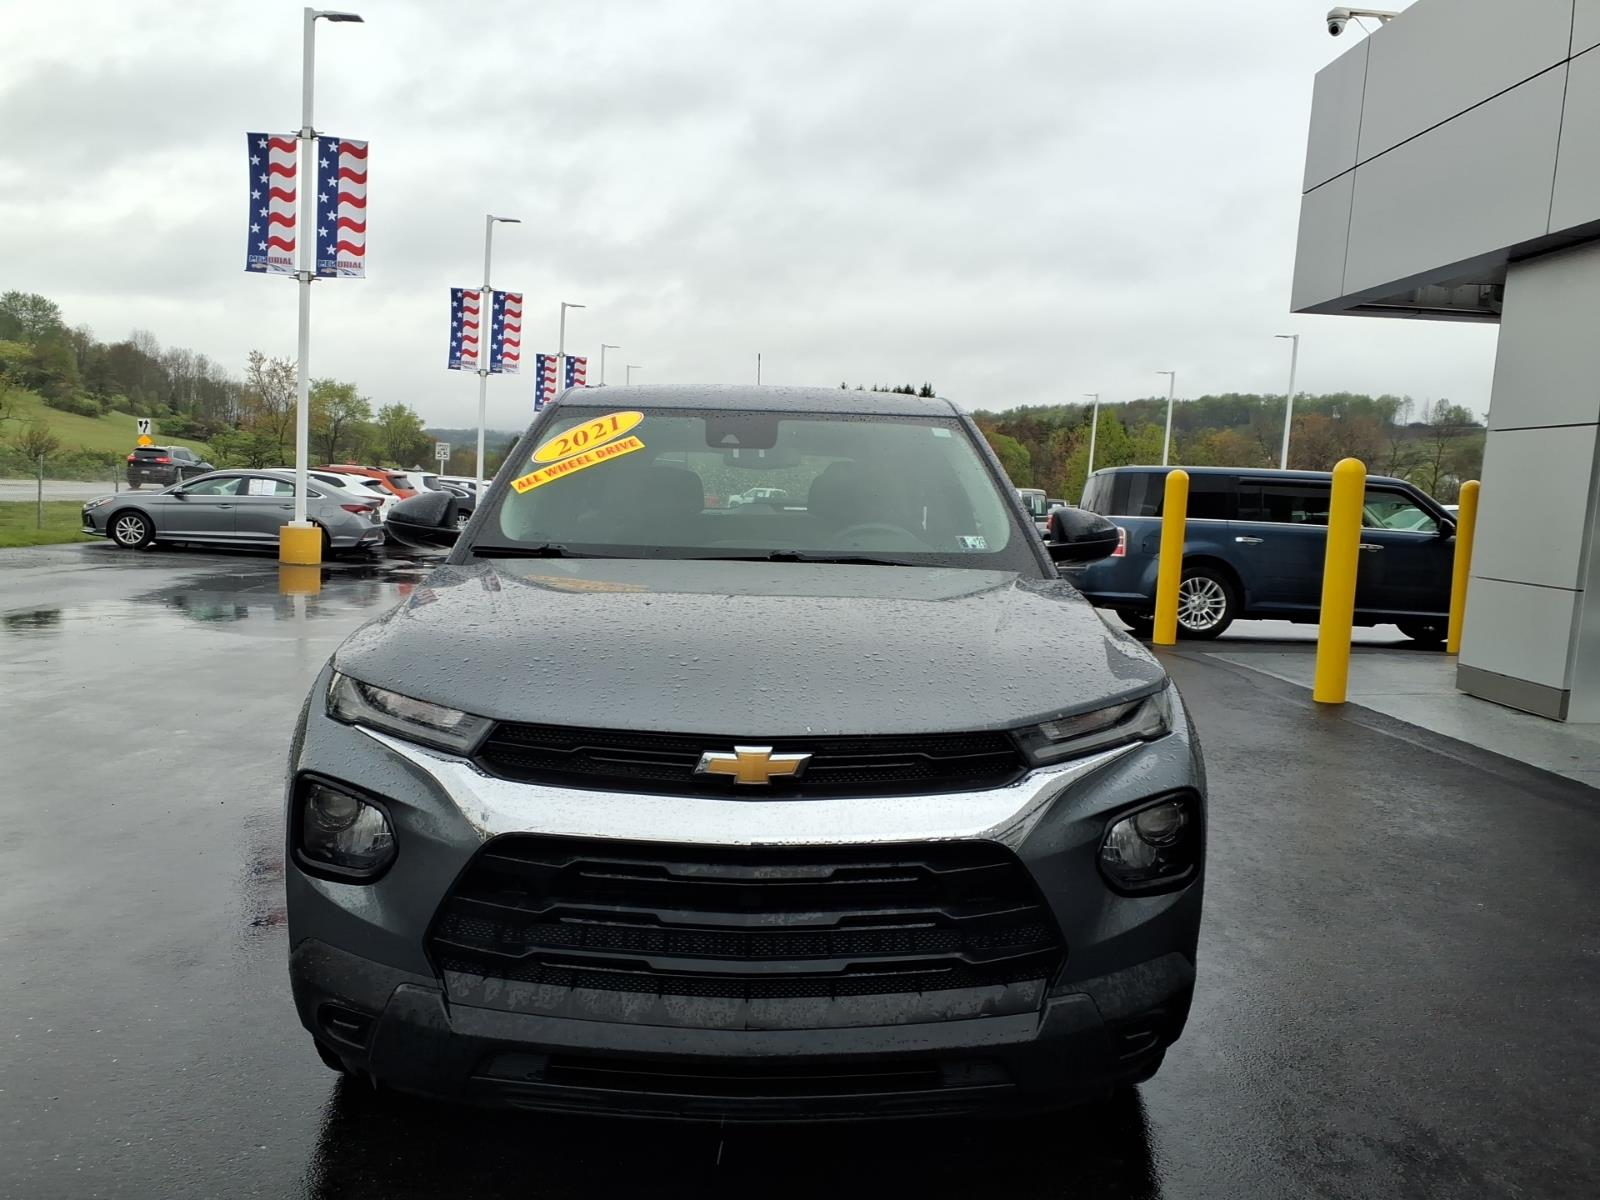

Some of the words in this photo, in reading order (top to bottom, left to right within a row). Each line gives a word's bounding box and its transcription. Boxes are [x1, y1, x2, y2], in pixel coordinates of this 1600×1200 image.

[555, 416, 620, 456] 2021
[517, 474, 541, 490] ALL
[543, 455, 593, 477] WHEEL
[596, 438, 638, 458] DRIVE
